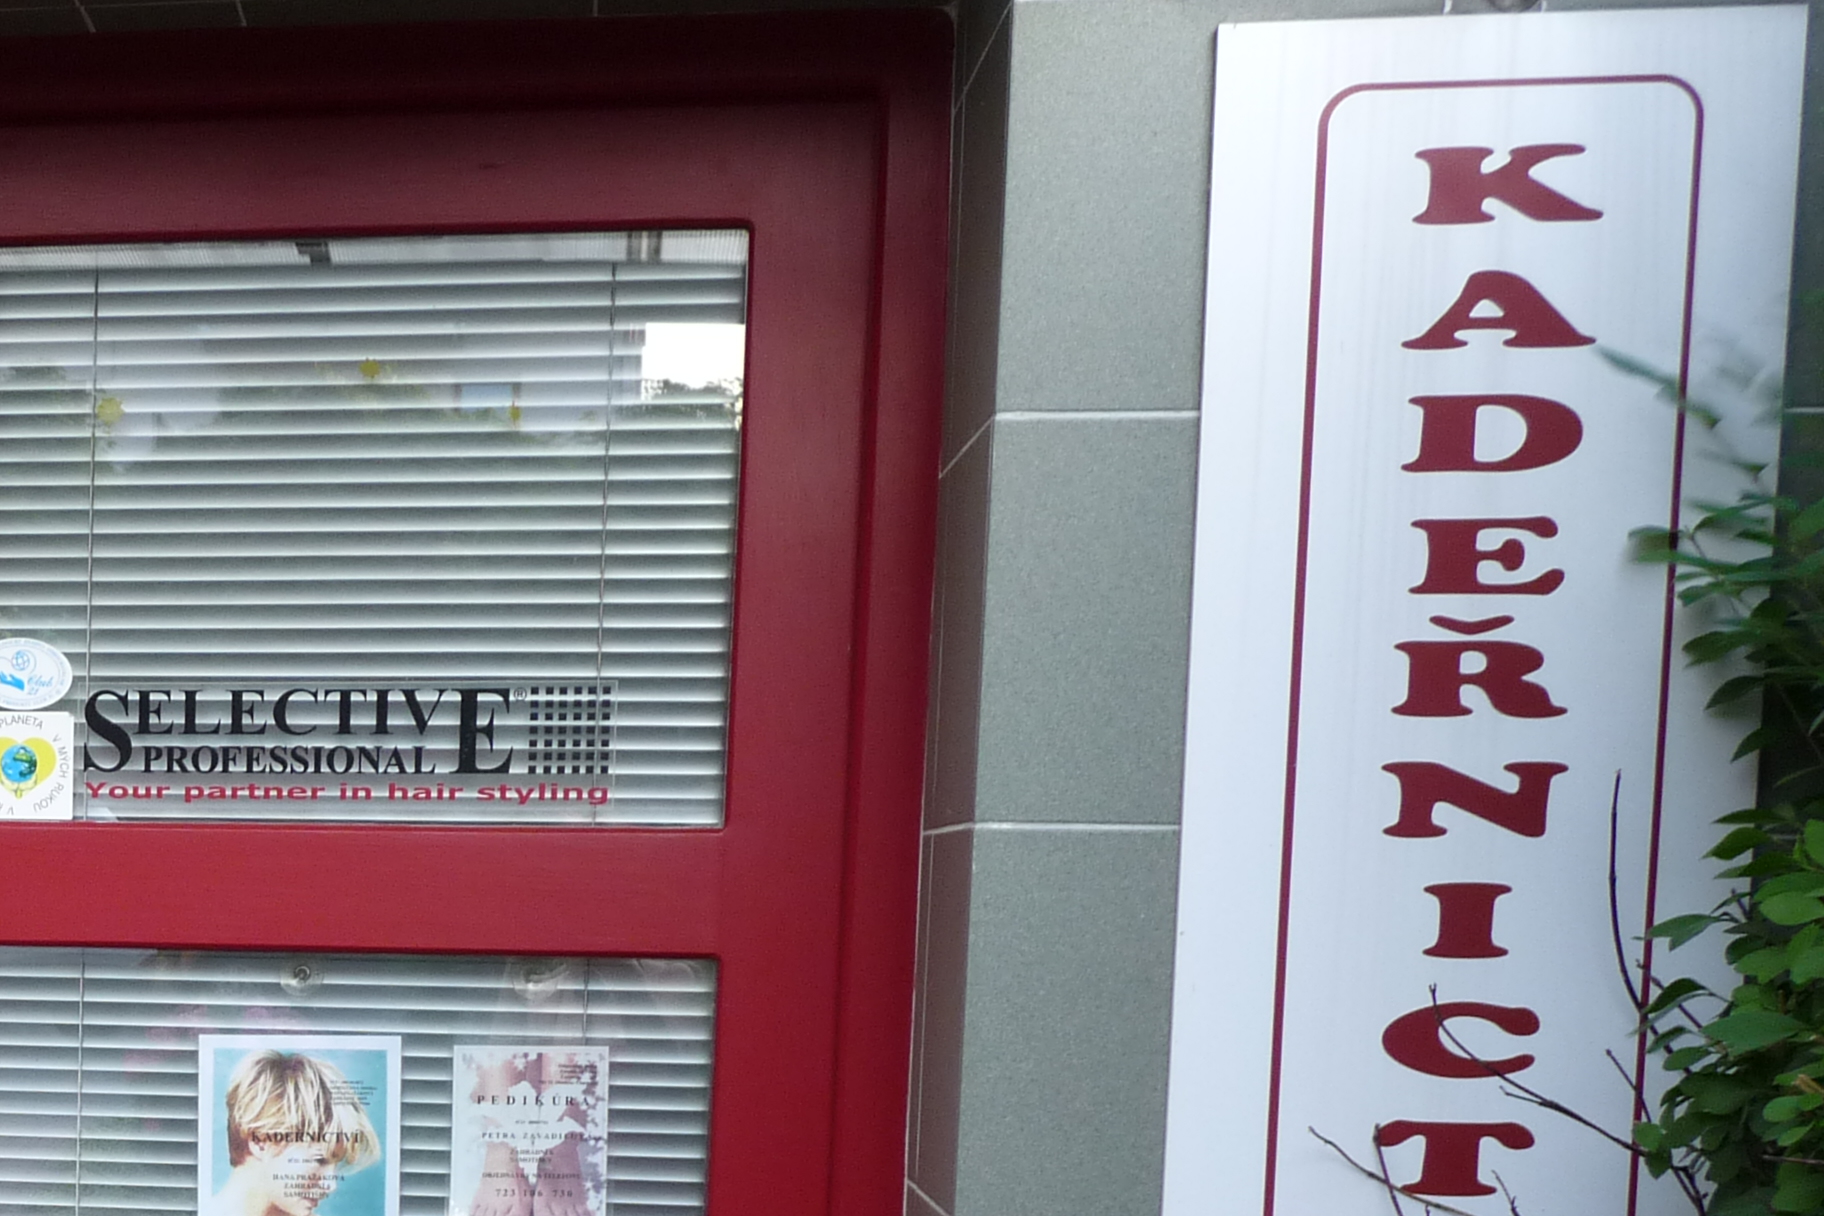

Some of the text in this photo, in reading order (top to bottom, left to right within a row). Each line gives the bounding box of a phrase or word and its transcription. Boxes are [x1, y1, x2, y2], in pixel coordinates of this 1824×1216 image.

[83, 687, 514, 774] SELECTIVE
[33, 733, 71, 813] V MÝCH RUKOU
[141, 745, 436, 775] PROFESSIONAL
[84, 781, 610, 806] Your partner in hair styling
[476, 1093, 590, 1107] PEDIKÚRA
